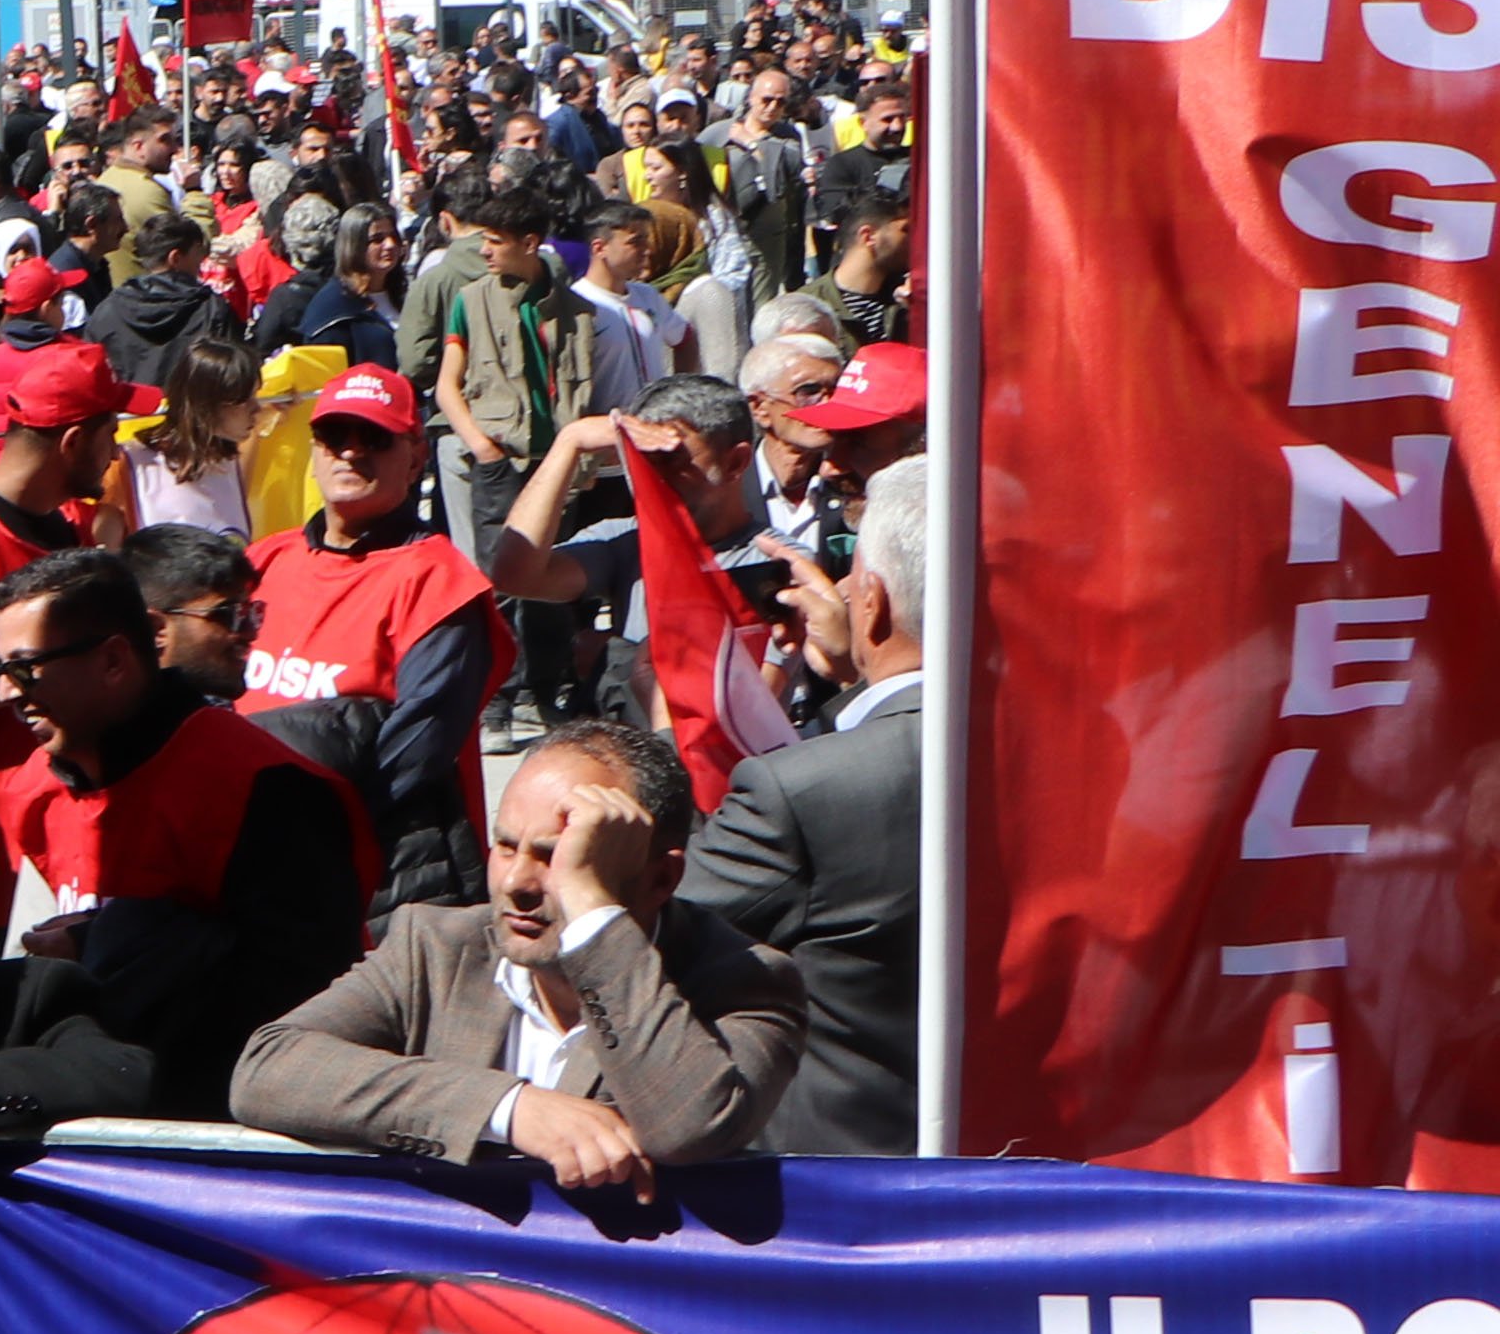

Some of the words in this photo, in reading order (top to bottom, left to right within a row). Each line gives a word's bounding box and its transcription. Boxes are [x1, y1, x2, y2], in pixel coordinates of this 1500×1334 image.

[346, 372, 385, 390] DİSK
[244, 647, 349, 700] DİSK
[1220, 138, 1496, 1175] GENEL-İ
